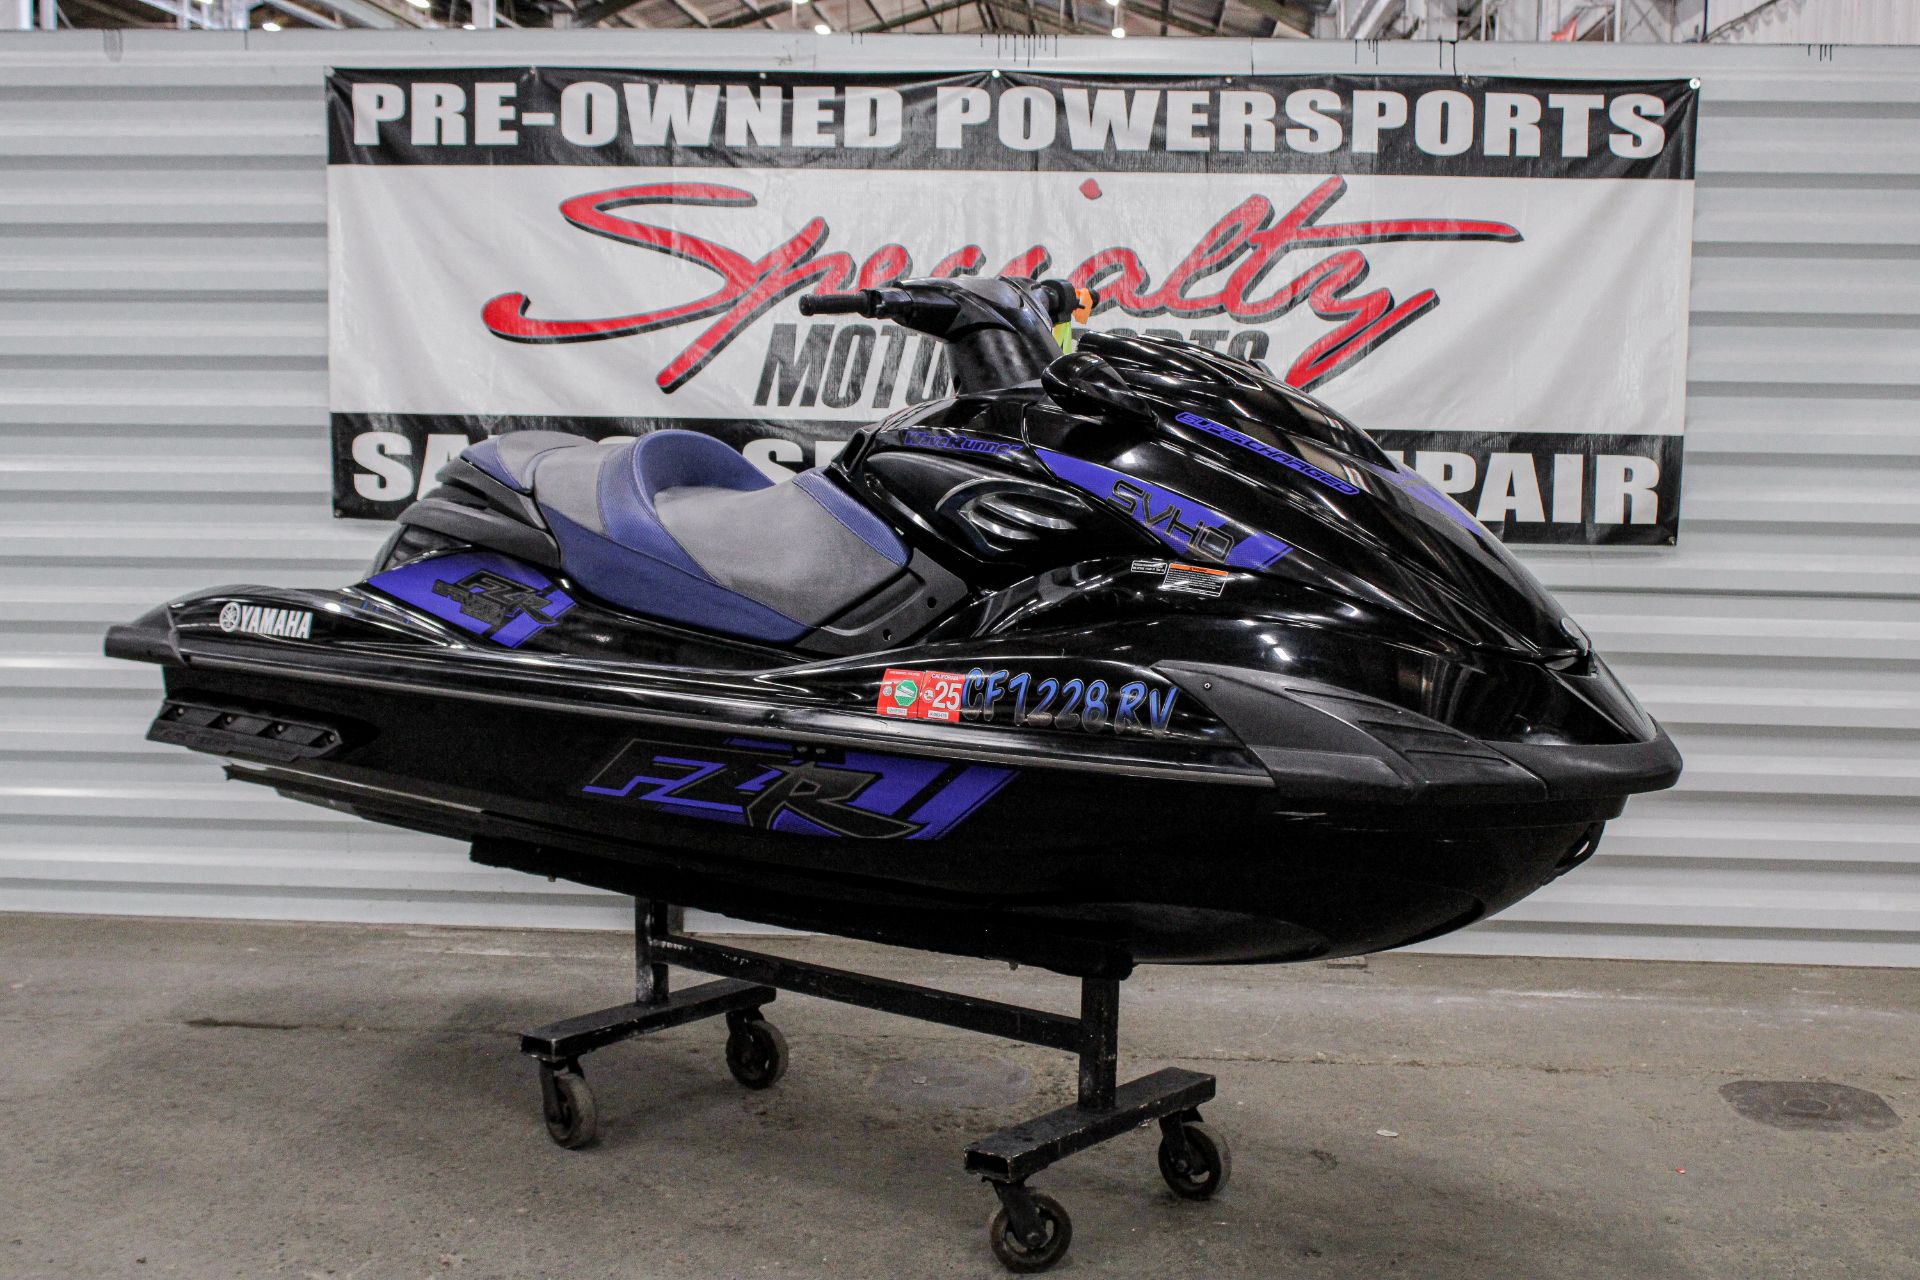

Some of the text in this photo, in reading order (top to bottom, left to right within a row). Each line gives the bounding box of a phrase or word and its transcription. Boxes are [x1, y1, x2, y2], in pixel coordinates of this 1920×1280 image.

[352, 82, 1666, 159] PRE-OWNED POWERSPORTS
[481, 175, 1525, 394] Specialty
[1177, 411, 1359, 494] SUPERCHARGED
[1386, 449, 1661, 525] PAIR
[1105, 479, 1234, 564] SVHO
[240, 604, 313, 639] YAMAHA
[932, 681, 962, 710] 25
